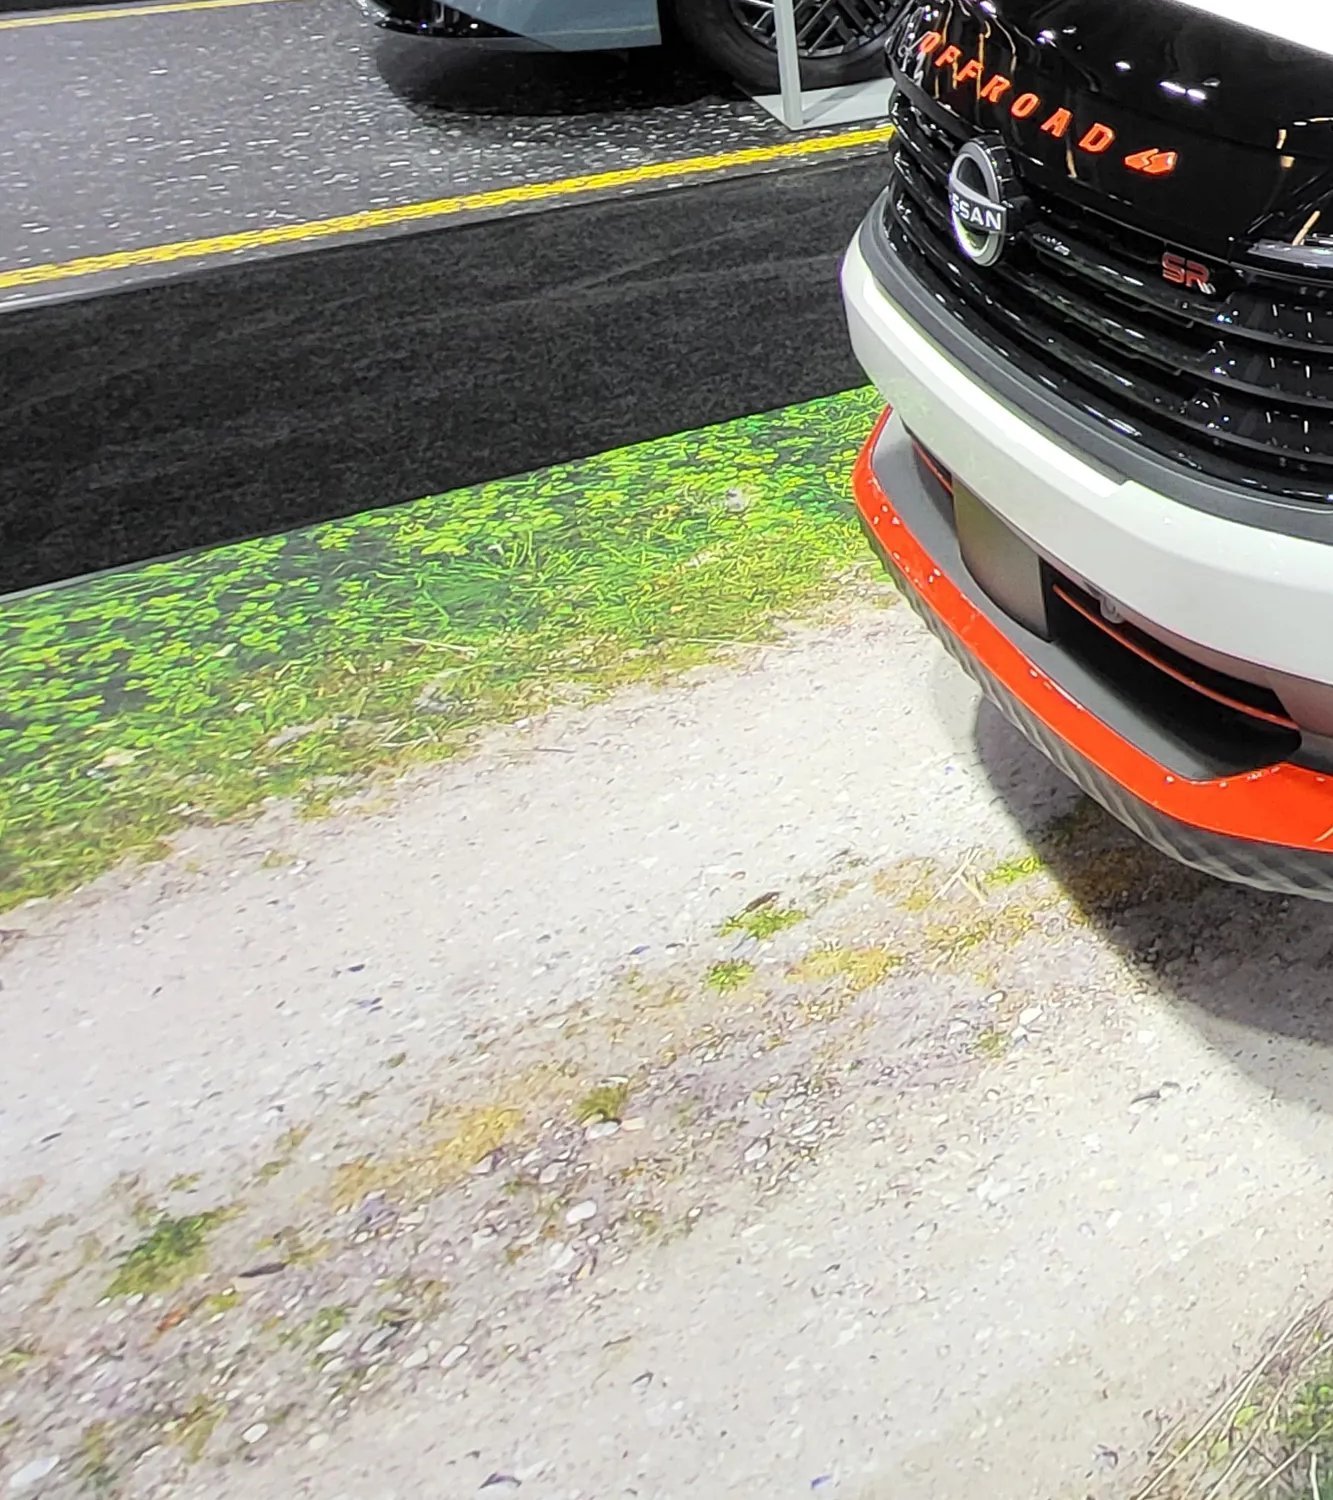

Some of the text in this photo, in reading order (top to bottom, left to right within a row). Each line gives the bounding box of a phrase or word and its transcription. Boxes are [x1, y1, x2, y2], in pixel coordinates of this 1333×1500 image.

[918, 30, 1116, 153] OFFROAD
[949, 192, 1001, 230] SSAN
[1161, 251, 1213, 295] SR
